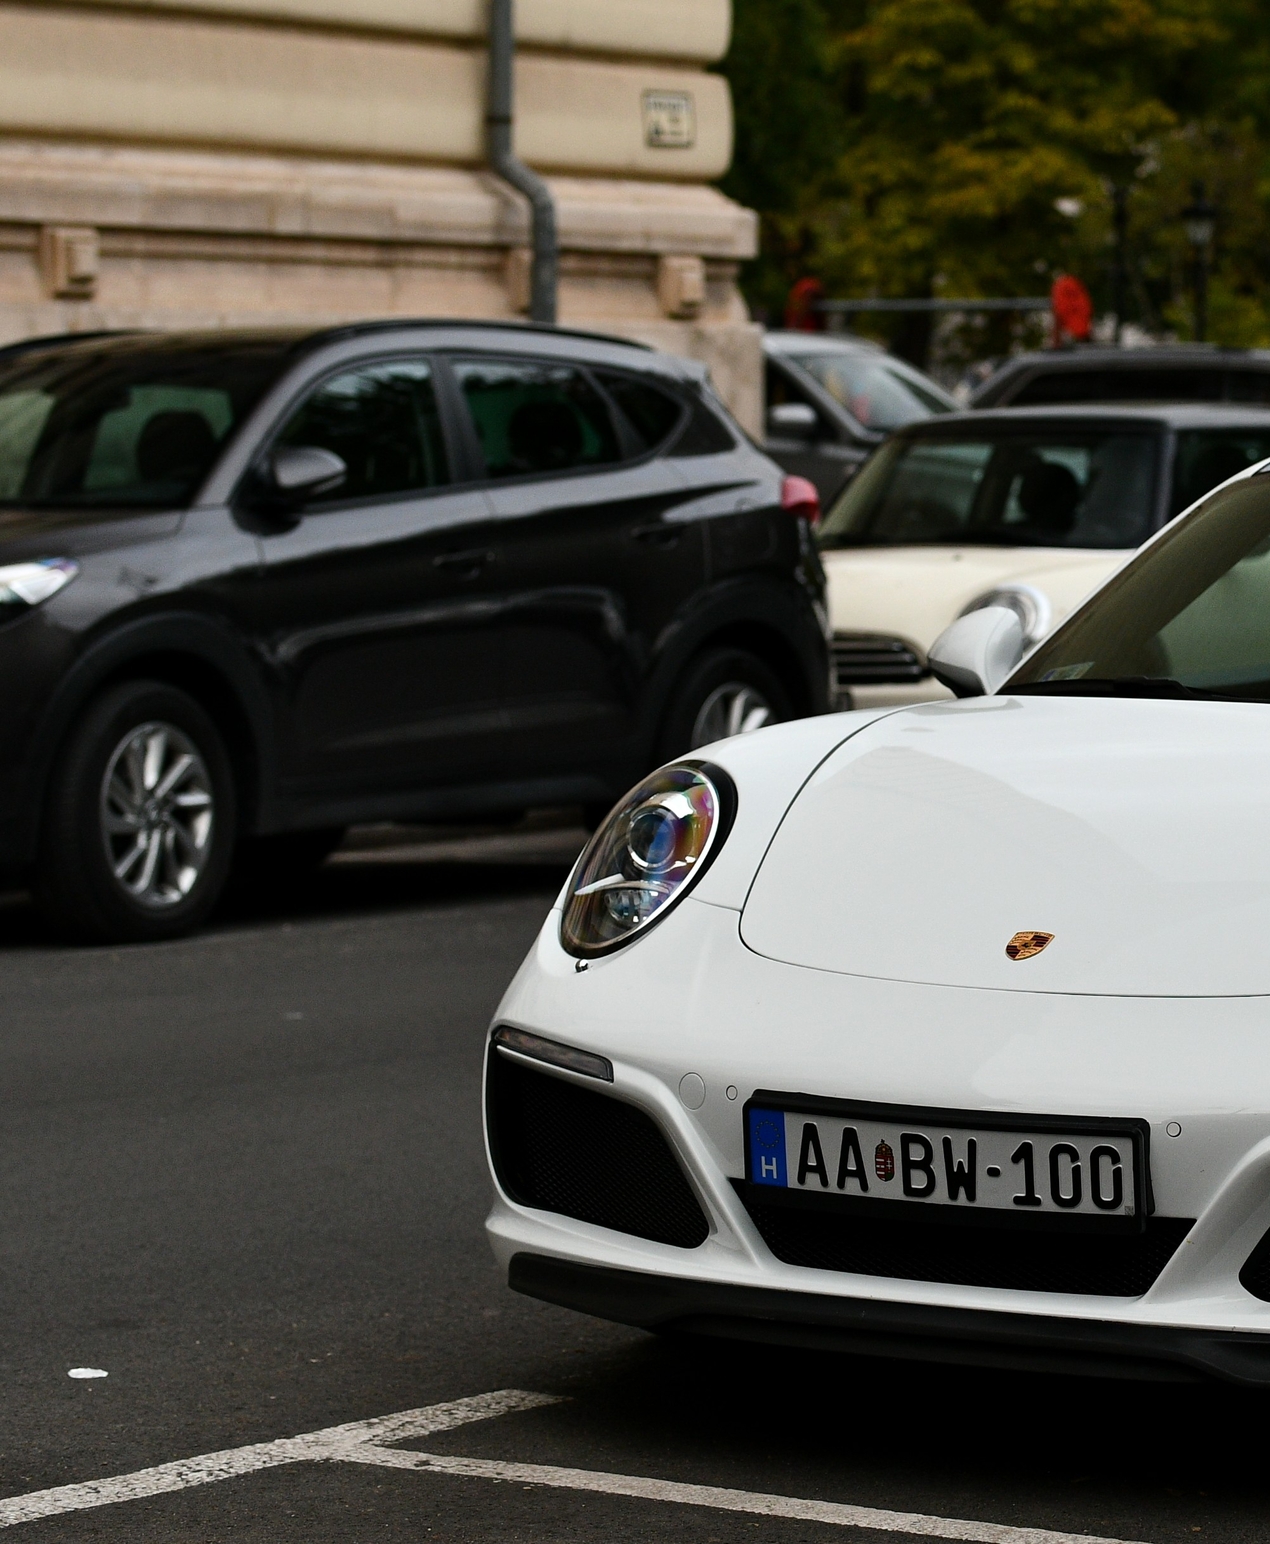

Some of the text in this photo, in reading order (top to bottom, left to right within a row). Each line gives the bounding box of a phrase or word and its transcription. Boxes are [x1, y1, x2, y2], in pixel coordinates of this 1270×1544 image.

[760, 1155, 778, 1180] H
[797, 1121, 1123, 1210] AA BW-100
